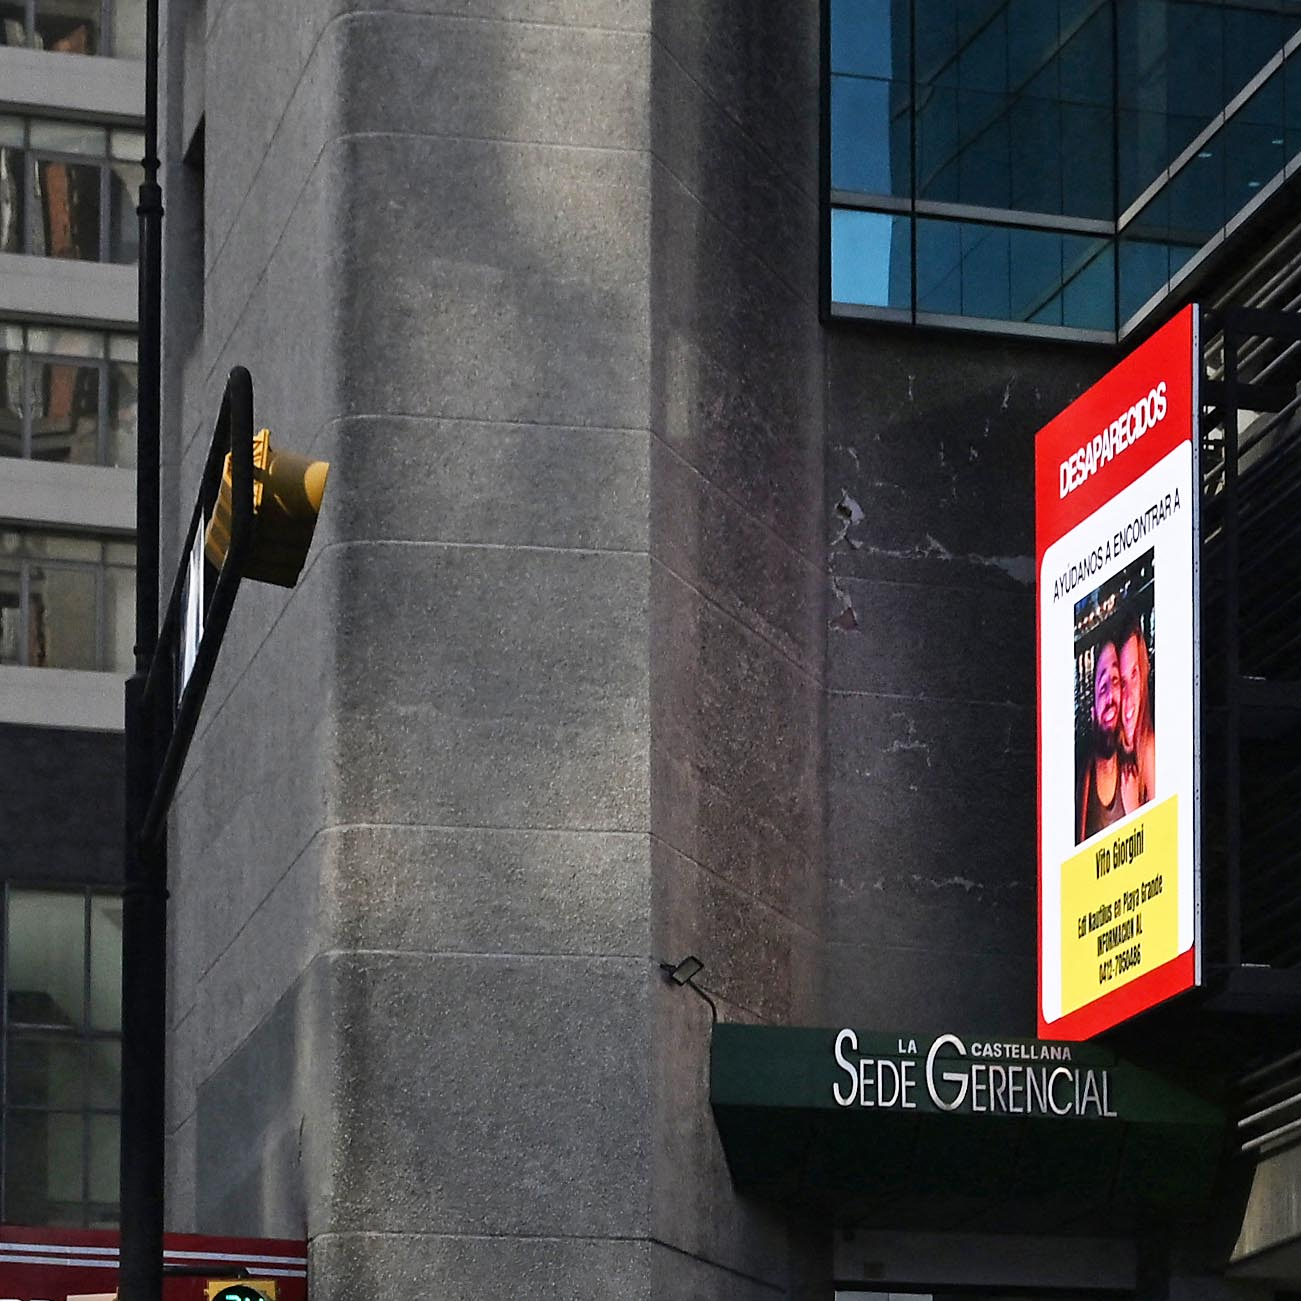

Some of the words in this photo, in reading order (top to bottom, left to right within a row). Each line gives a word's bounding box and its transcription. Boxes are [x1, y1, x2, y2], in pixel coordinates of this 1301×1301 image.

[1060, 381, 1167, 499] DESAPARECIDOS
[1053, 546, 1104, 603] AYÚDANOS
[1105, 540, 1112, 567] A
[1113, 494, 1172, 558] ENCONTRAR
[1173, 488, 1181, 512] A
[1096, 848, 1111, 880] Vito
[1113, 824, 1144, 870] Giorgini
[1114, 899, 1122, 919] en
[1123, 886, 1139, 913] Playa
[1141, 873, 1163, 904] Grande
[1097, 916, 1135, 957] INFORMACION
[1135, 912, 1143, 936] AL
[898, 1039, 918, 1054] LA
[971, 1043, 1071, 1061] CASTELLANA
